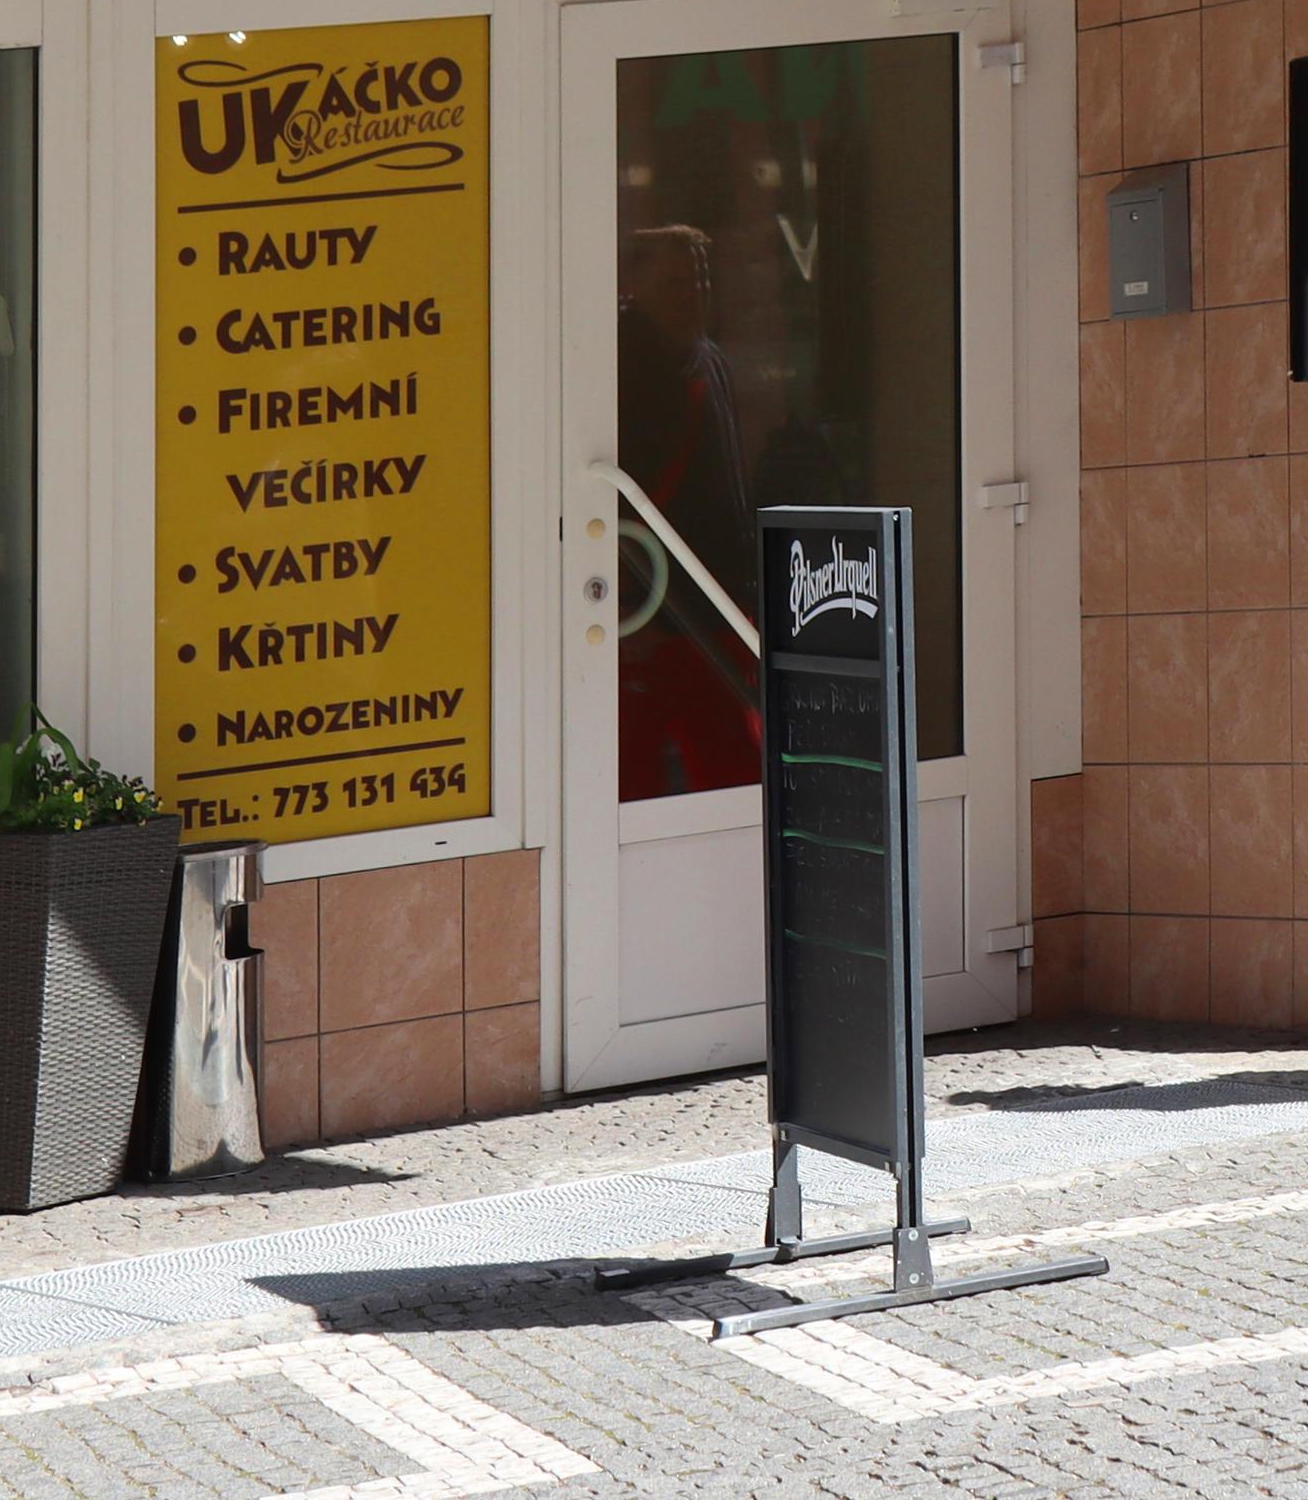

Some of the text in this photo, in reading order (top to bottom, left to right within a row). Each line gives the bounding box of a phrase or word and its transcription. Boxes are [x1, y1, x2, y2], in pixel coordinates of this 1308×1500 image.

[284, 103, 465, 163] Restaurace
[218, 225, 378, 276] RAUTY
[216, 297, 440, 354] CATERING
[218, 371, 418, 434] FIREMNÍ
[226, 454, 426, 513] VEČÍRKY
[215, 536, 391, 593] SVATBY
[790, 535, 877, 637] Pilsner Urquell
[218, 613, 399, 672] KŘTINY
[217, 688, 464, 747] NAROZENINY
[177, 794, 259, 830] TEL.:
[273, 781, 329, 818] 773
[342, 772, 394, 808] 131
